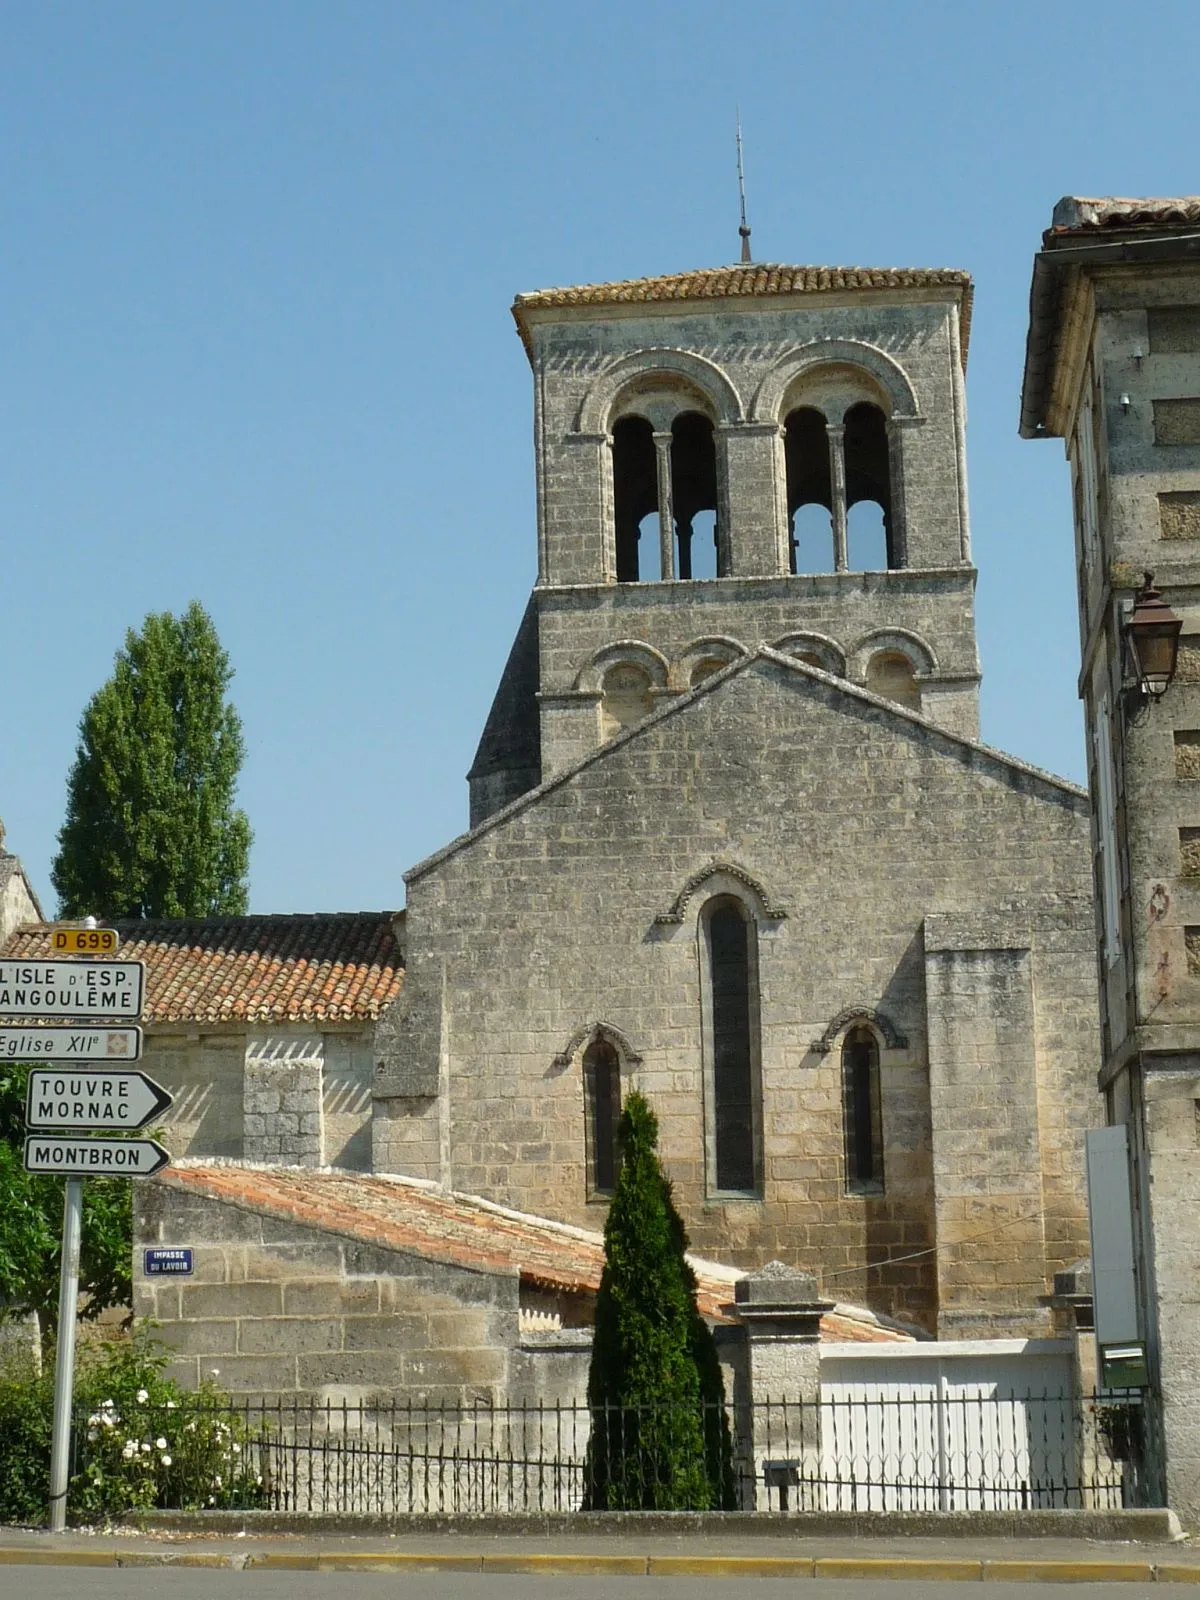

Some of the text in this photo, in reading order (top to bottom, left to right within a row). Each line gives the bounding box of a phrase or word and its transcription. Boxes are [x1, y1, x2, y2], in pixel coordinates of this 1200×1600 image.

[56, 933, 113, 949] D 699
[0, 987, 132, 1008] ANGOULÊME
[40, 1080, 129, 1097] TOUVRE
[38, 1101, 129, 1119] MORNAC
[35, 1147, 140, 1166] MONTBRON
[153, 1251, 185, 1259] IMPASSE
[150, 1262, 188, 1271] DU LAVOIR
